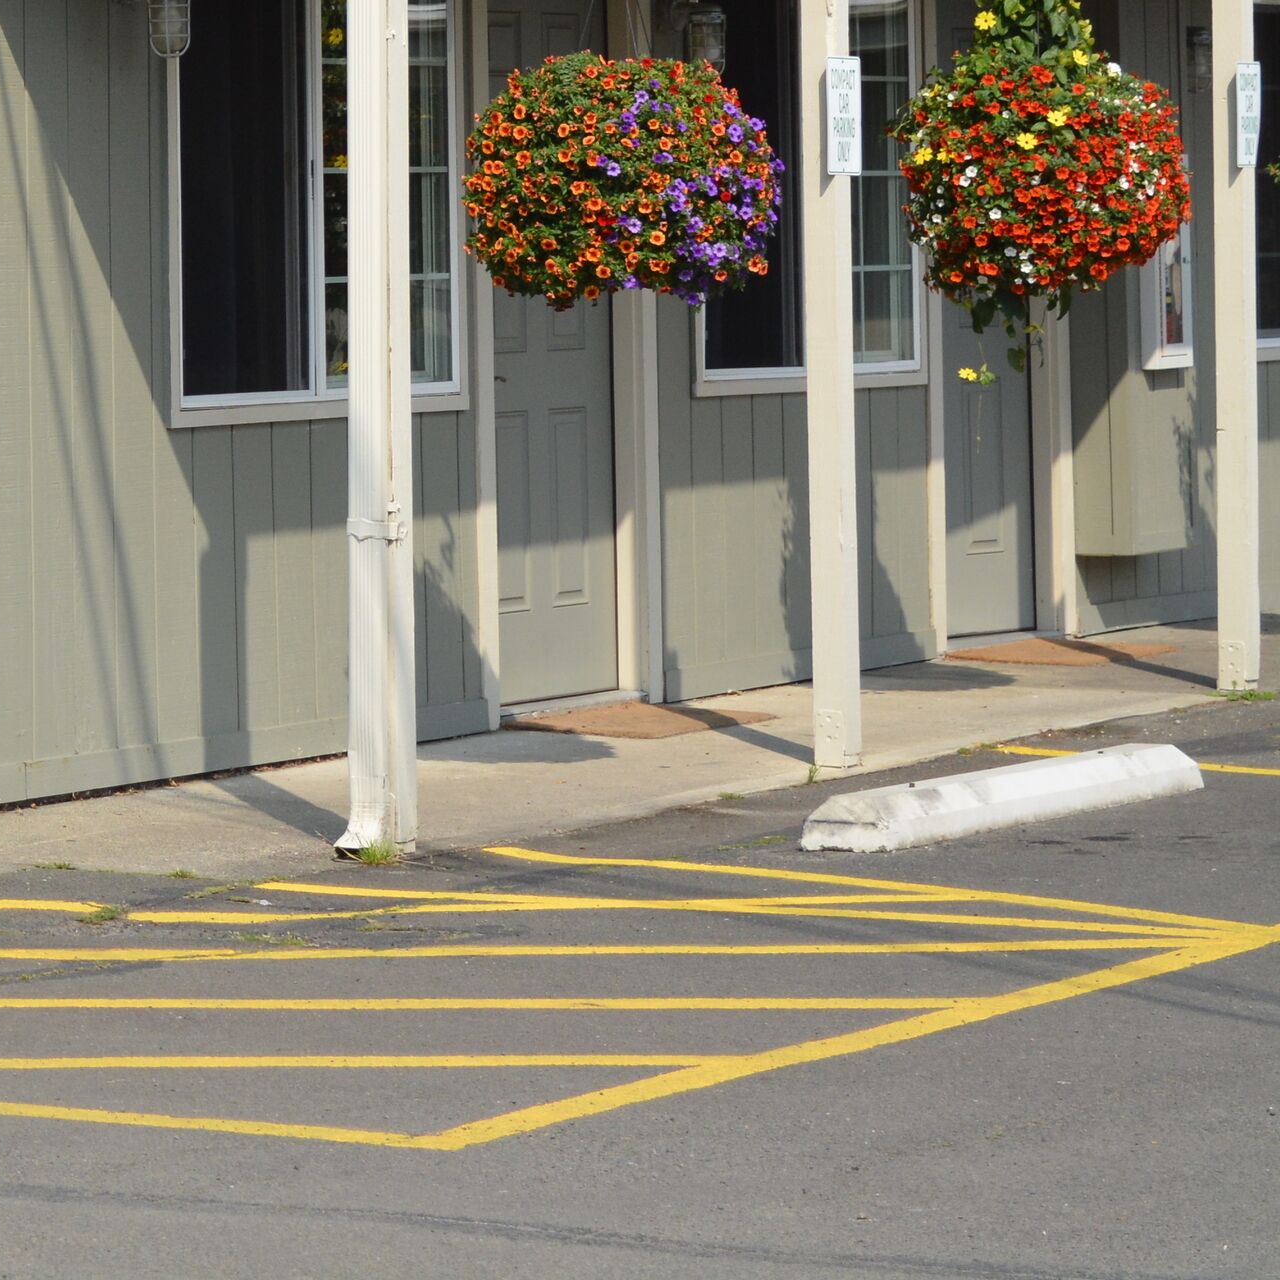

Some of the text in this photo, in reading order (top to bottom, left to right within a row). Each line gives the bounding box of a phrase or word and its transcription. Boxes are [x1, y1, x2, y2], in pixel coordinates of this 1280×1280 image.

[831, 69, 856, 90] COMPACT
[838, 93, 850, 114] CAR
[833, 117, 855, 138] PARKING
[837, 141, 851, 162] ONLY
